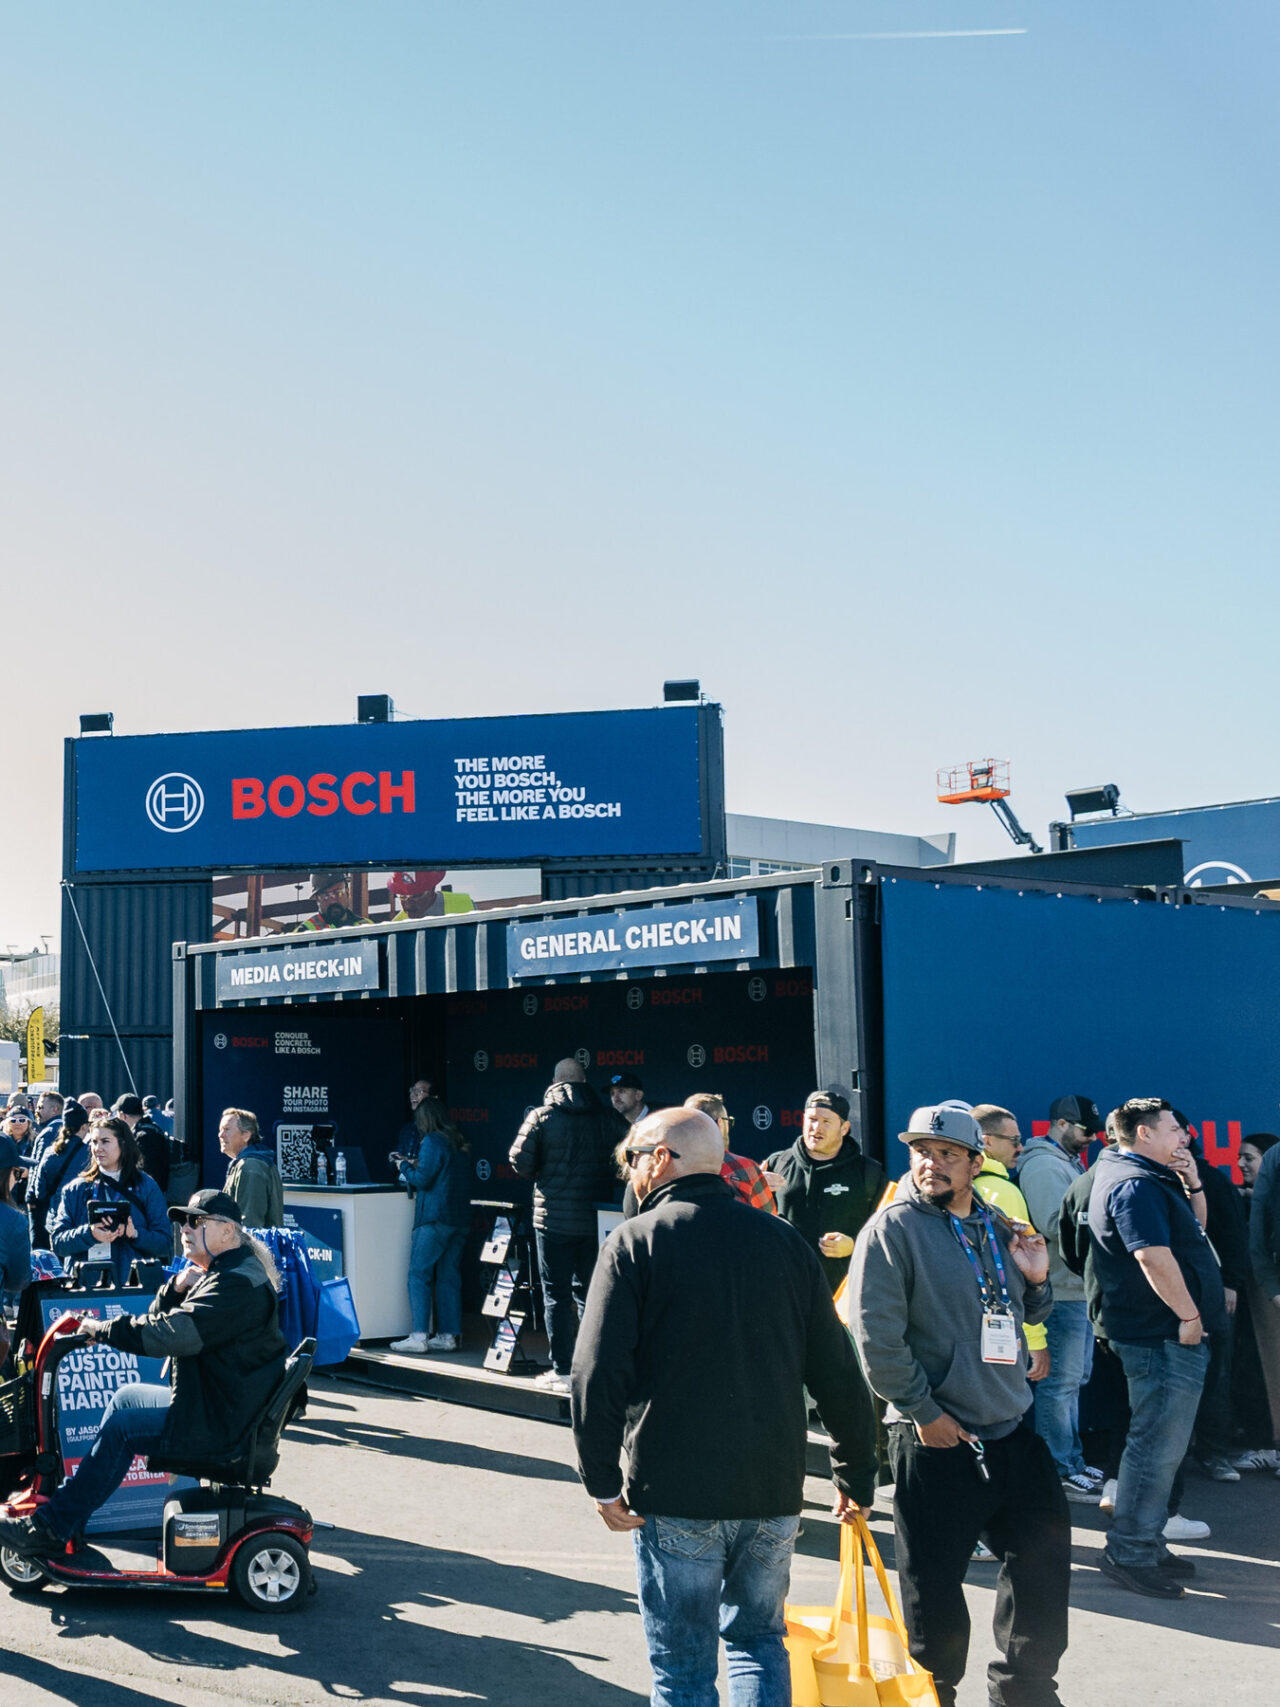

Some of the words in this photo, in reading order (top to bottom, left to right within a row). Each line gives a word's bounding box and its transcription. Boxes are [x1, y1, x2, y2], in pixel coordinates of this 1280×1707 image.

[454, 758, 489, 772] THE
[492, 755, 545, 771] MORE
[454, 774, 491, 789] YOU
[494, 772, 562, 788] BOSCH,
[232, 771, 416, 819] BOSCH
[455, 791, 490, 805] THE
[493, 789, 546, 804] MORE
[548, 787, 586, 802] YOU
[456, 807, 498, 822] FEEL
[501, 806, 540, 820] LIKE
[542, 805, 556, 819] A
[559, 803, 622, 819] BOSCH
[521, 929, 621, 960] GENERAL
[625, 914, 742, 950] CHECK-IN
[230, 965, 281, 986] MEDIA
[283, 956, 363, 981] CHECK-IN
[596, 1050, 645, 1066] BOSCH
[713, 1045, 768, 1063] BOSCH
[283, 1086, 328, 1099] SHARE
[59, 1352, 139, 1374] CUSTOM
[58, 1369, 141, 1392] PAINTED
[65, 1427, 76, 1436] BY
[78, 1425, 101, 1435] JASO
[127, 1472, 138, 1481] TO
